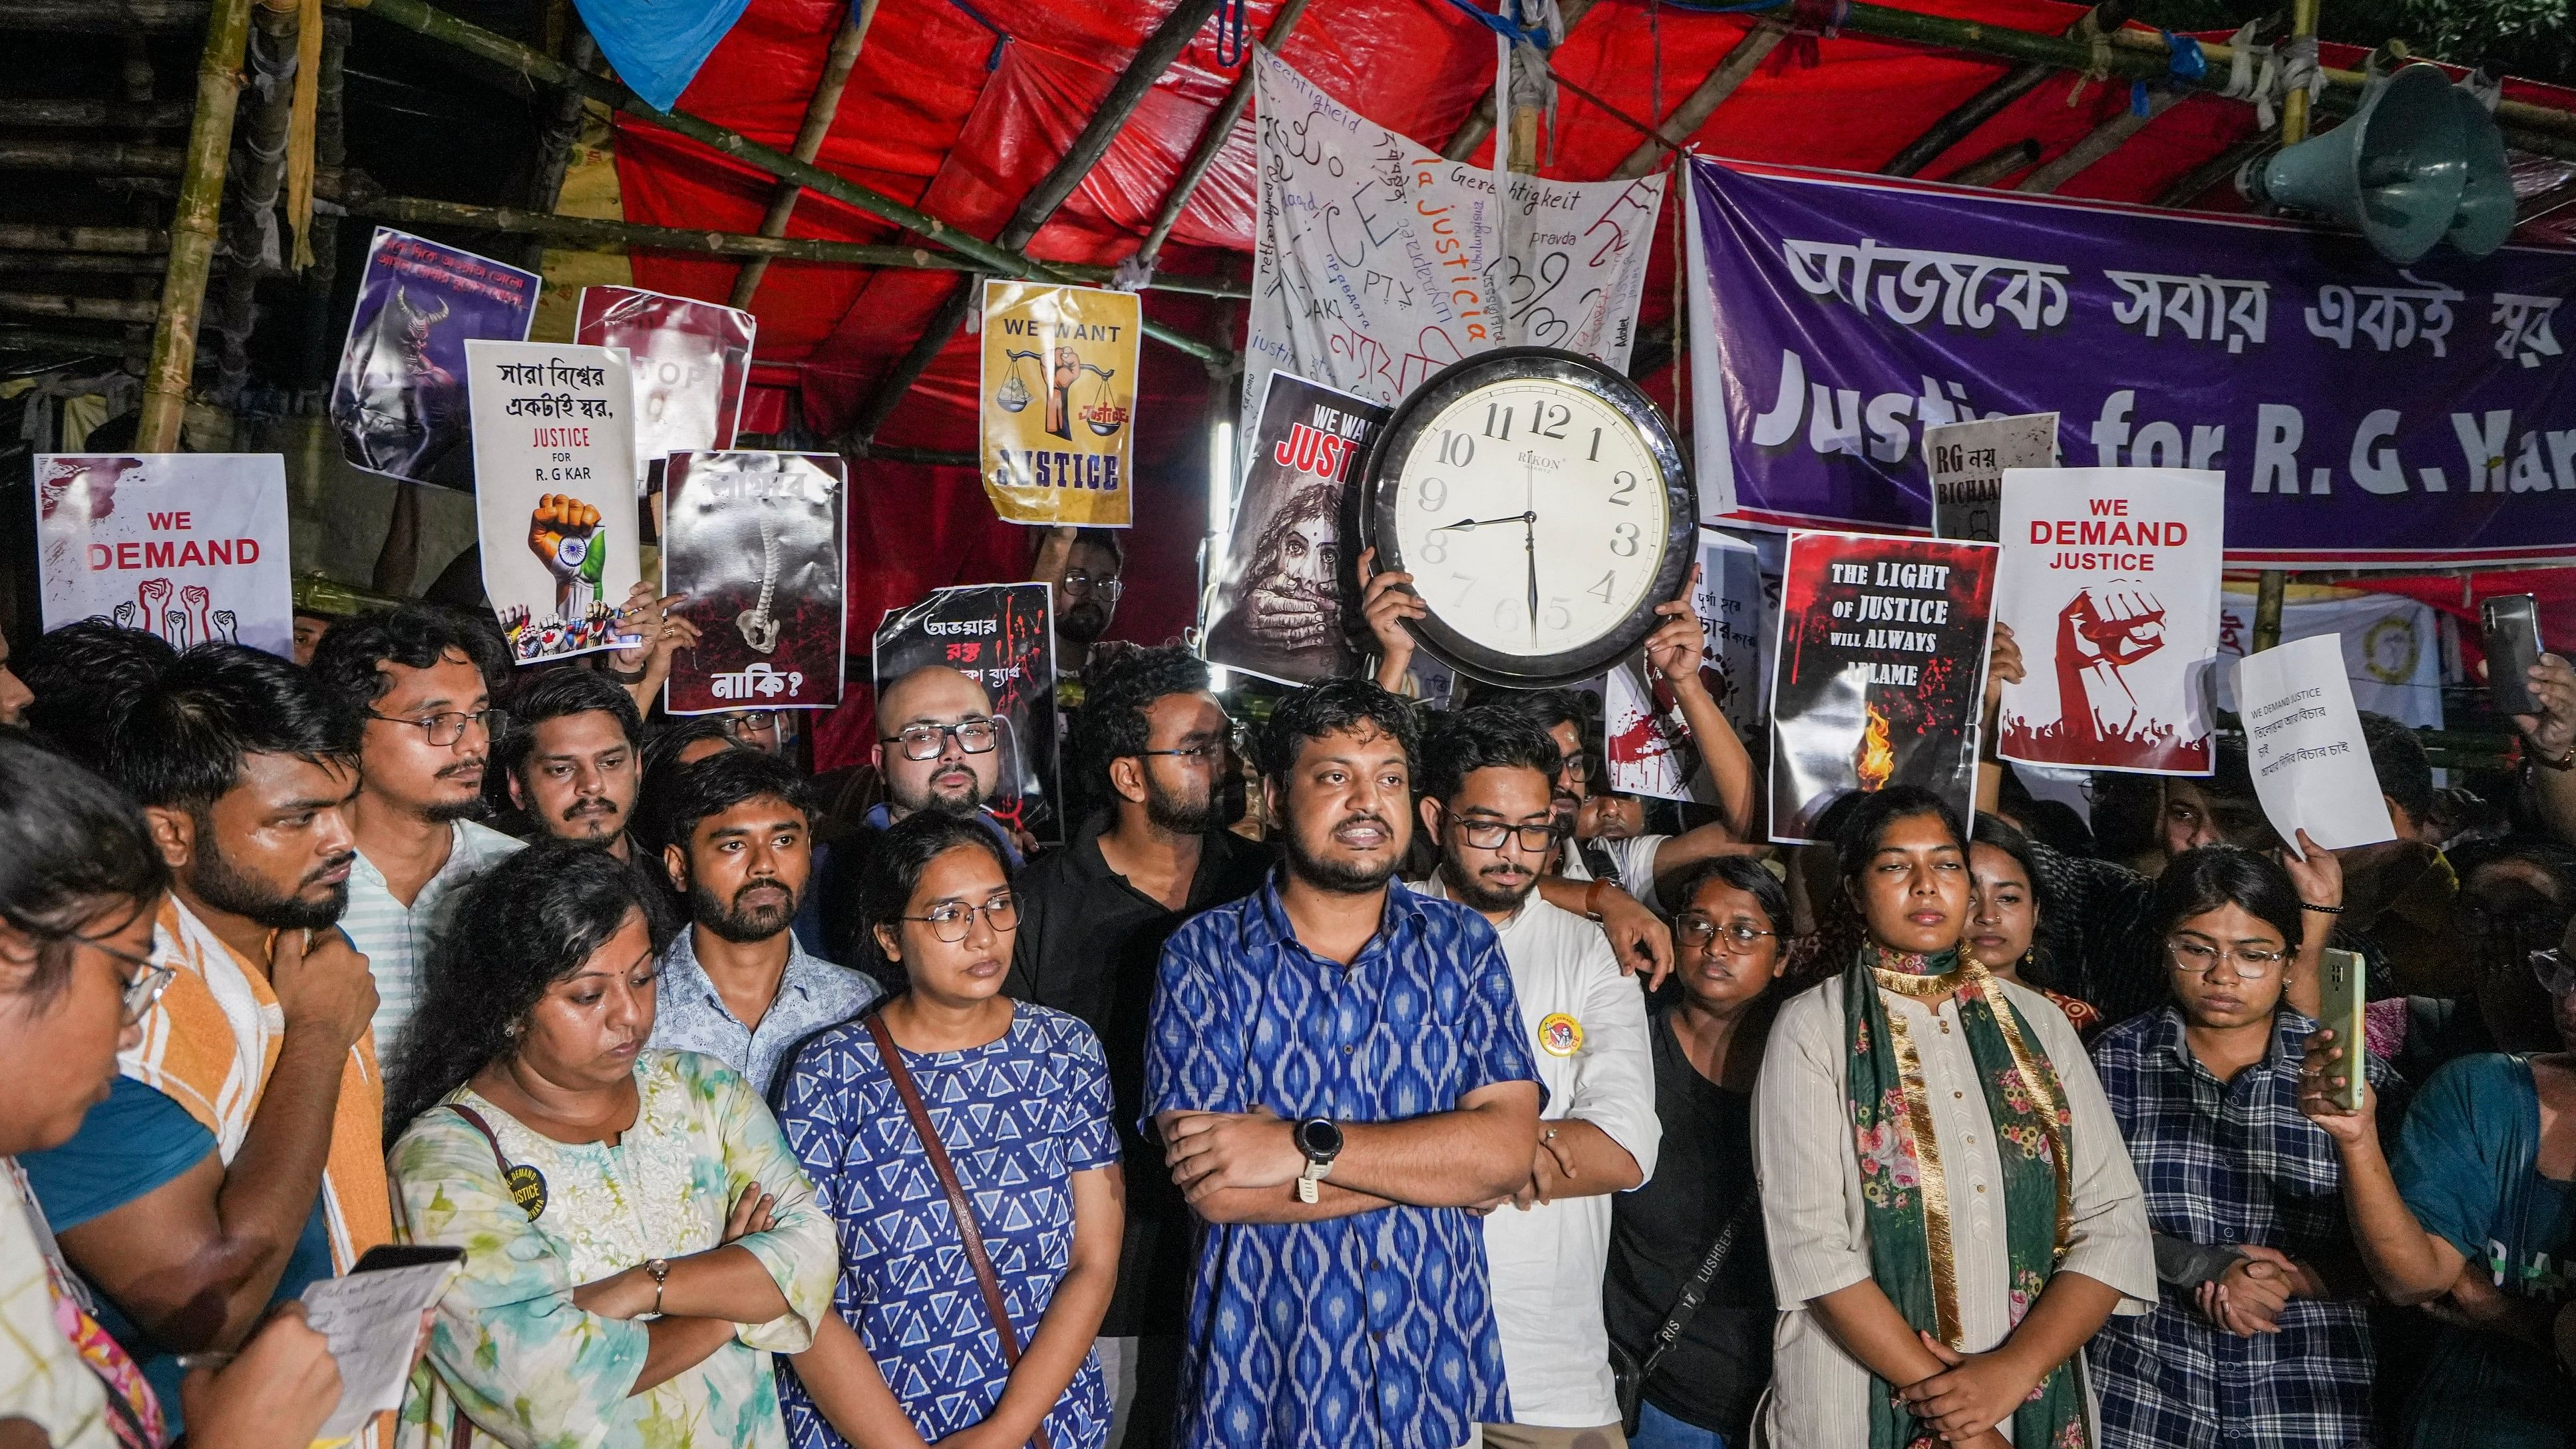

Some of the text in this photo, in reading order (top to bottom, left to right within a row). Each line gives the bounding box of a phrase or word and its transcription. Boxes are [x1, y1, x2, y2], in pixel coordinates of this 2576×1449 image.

[1451, 166, 1581, 215] Gerehtigkeit
[1530, 232, 1576, 246] pravda
[1781, 238, 2070, 331] আজকে
[2104, 270, 2271, 353] সবার
[2304, 269, 2465, 357] একই
[1004, 318, 1121, 342] WE WANT
[496, 357, 604, 387] সারা বিশ্বের
[634, 356, 705, 389] TOP
[506, 393, 613, 420] একটাই স্বর,
[1312, 403, 1341, 433] WE
[1529, 400, 1571, 439] 12
[1752, 347, 2062, 467] Justi
[2092, 389, 2225, 469] for
[2251, 403, 2331, 495] R.
[2350, 409, 2448, 495] G.
[1482, 403, 1514, 441] 11
[532, 427, 590, 448] JUSTICE
[1435, 429, 1475, 467] 10
[1586, 427, 1602, 462] 1
[552, 452, 571, 462] FOR
[998, 449, 1119, 491] JUSTICE
[1274, 422, 1368, 489] JUST
[1518, 452, 1561, 469] RIKON
[1936, 443, 1996, 474] RG নয়
[536, 467, 591, 481] R. G KAR
[1609, 471, 1636, 506] 2
[1419, 477, 1447, 512] 9
[1938, 477, 2002, 505] BICHAA
[148, 512, 192, 530] WE
[2090, 499, 2128, 517] WE
[1420, 530, 1449, 564] 8
[1610, 522, 1640, 557] 3
[2030, 520, 2188, 546] DEMAND
[87, 539, 260, 570] DEMAND
[2050, 552, 2155, 571] JUSTICE
[1450, 572, 1479, 608] 7
[1586, 570, 1616, 604] 4
[1832, 562, 1950, 591] THE LIGHT
[924, 614, 998, 636] অভয়ার
[1493, 599, 1521, 632] 6
[1545, 597, 1570, 630] 5
[1832, 595, 1948, 625] OF JUSTICE
[1696, 616, 1731, 641] চার
[1830, 630, 1937, 653] WILL ALWAYS
[946, 642, 982, 663] রক্ত
[711, 663, 803, 699] নাকি?
[2251, 688, 2321, 719] WE DEMAND JUSTICE
[2299, 707, 2326, 722] বিচার
[2258, 744, 2269, 758] চাই
[2297, 747, 2326, 761] বিচার
[2328, 741, 2350, 755] চাই
[511, 1168, 537, 1181] DEMAND
[512, 1183, 540, 1205] USTICE
[528, 1199, 544, 1220] BHAYA
